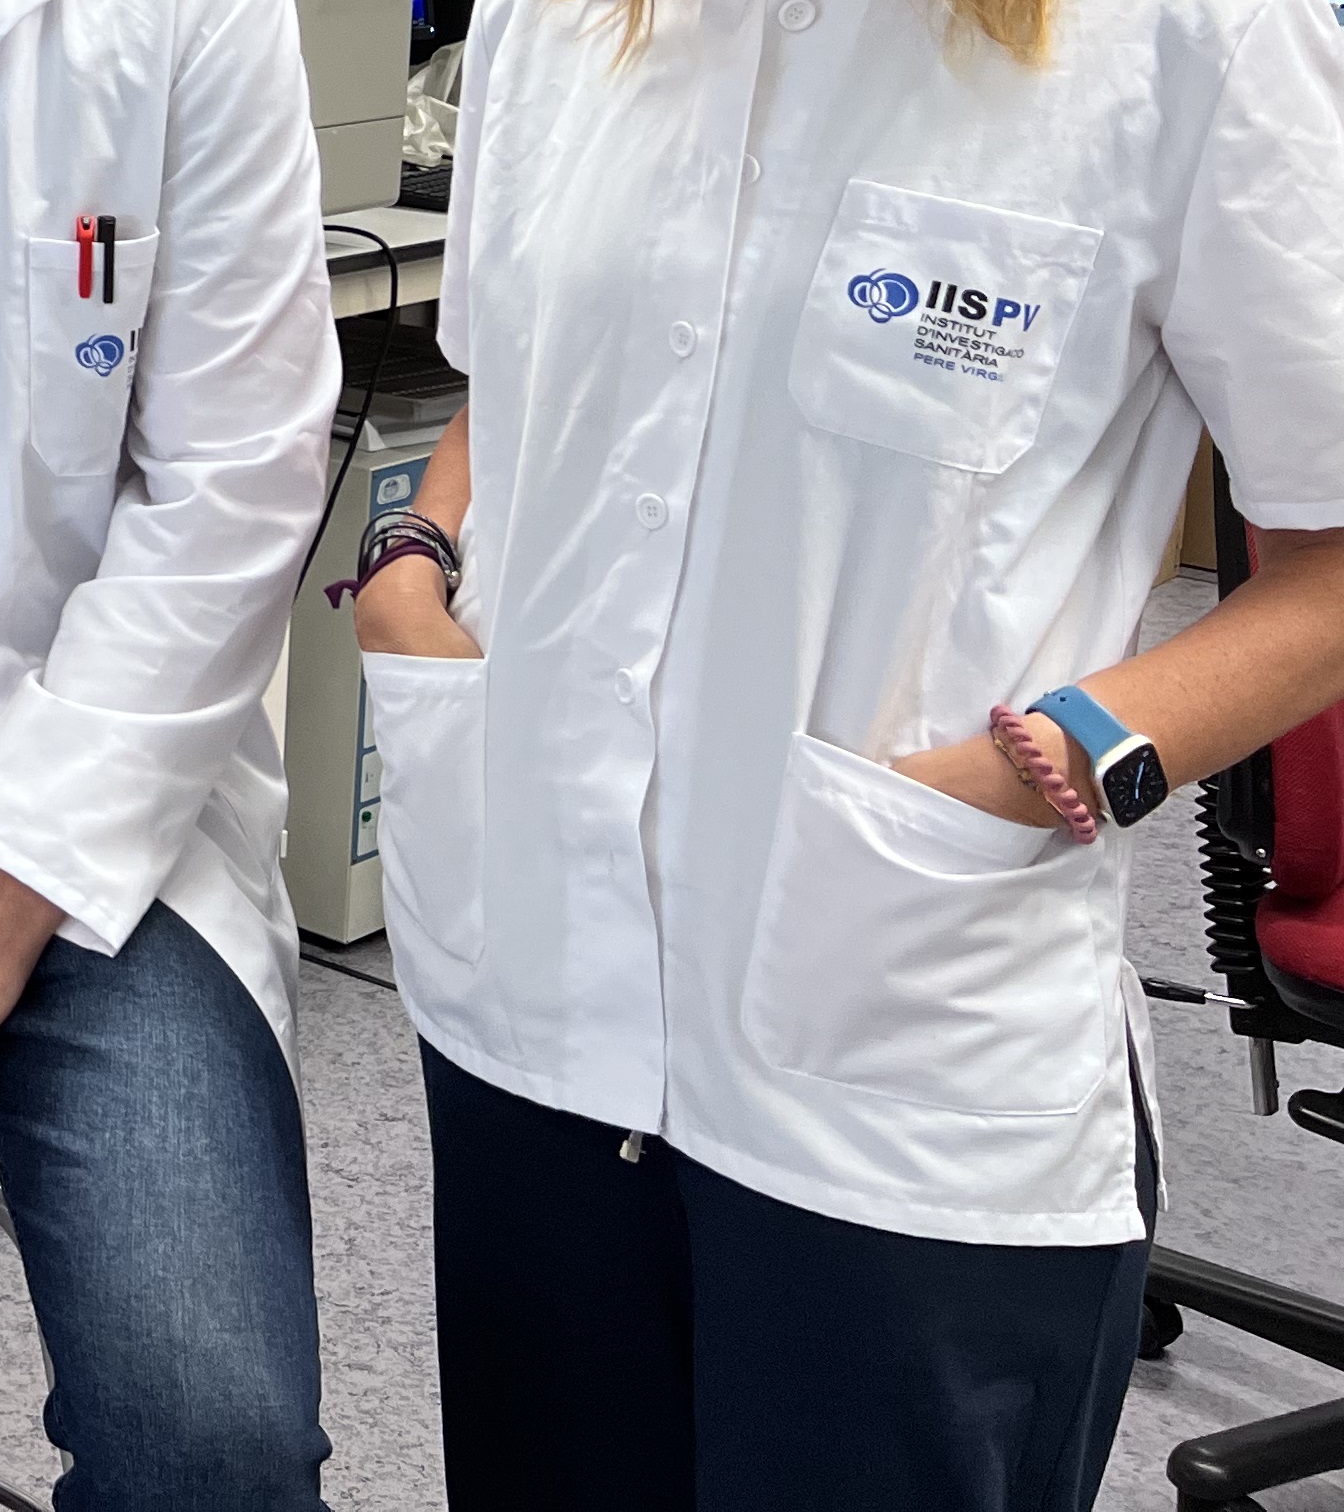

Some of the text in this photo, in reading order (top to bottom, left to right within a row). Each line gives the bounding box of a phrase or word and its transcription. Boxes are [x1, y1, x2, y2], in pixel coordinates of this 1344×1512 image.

[925, 279, 1041, 333] IISPV
[920, 313, 997, 341] INSTITUT
[913, 352, 956, 371] PERE
[914, 338, 999, 368] SANITÀRIA
